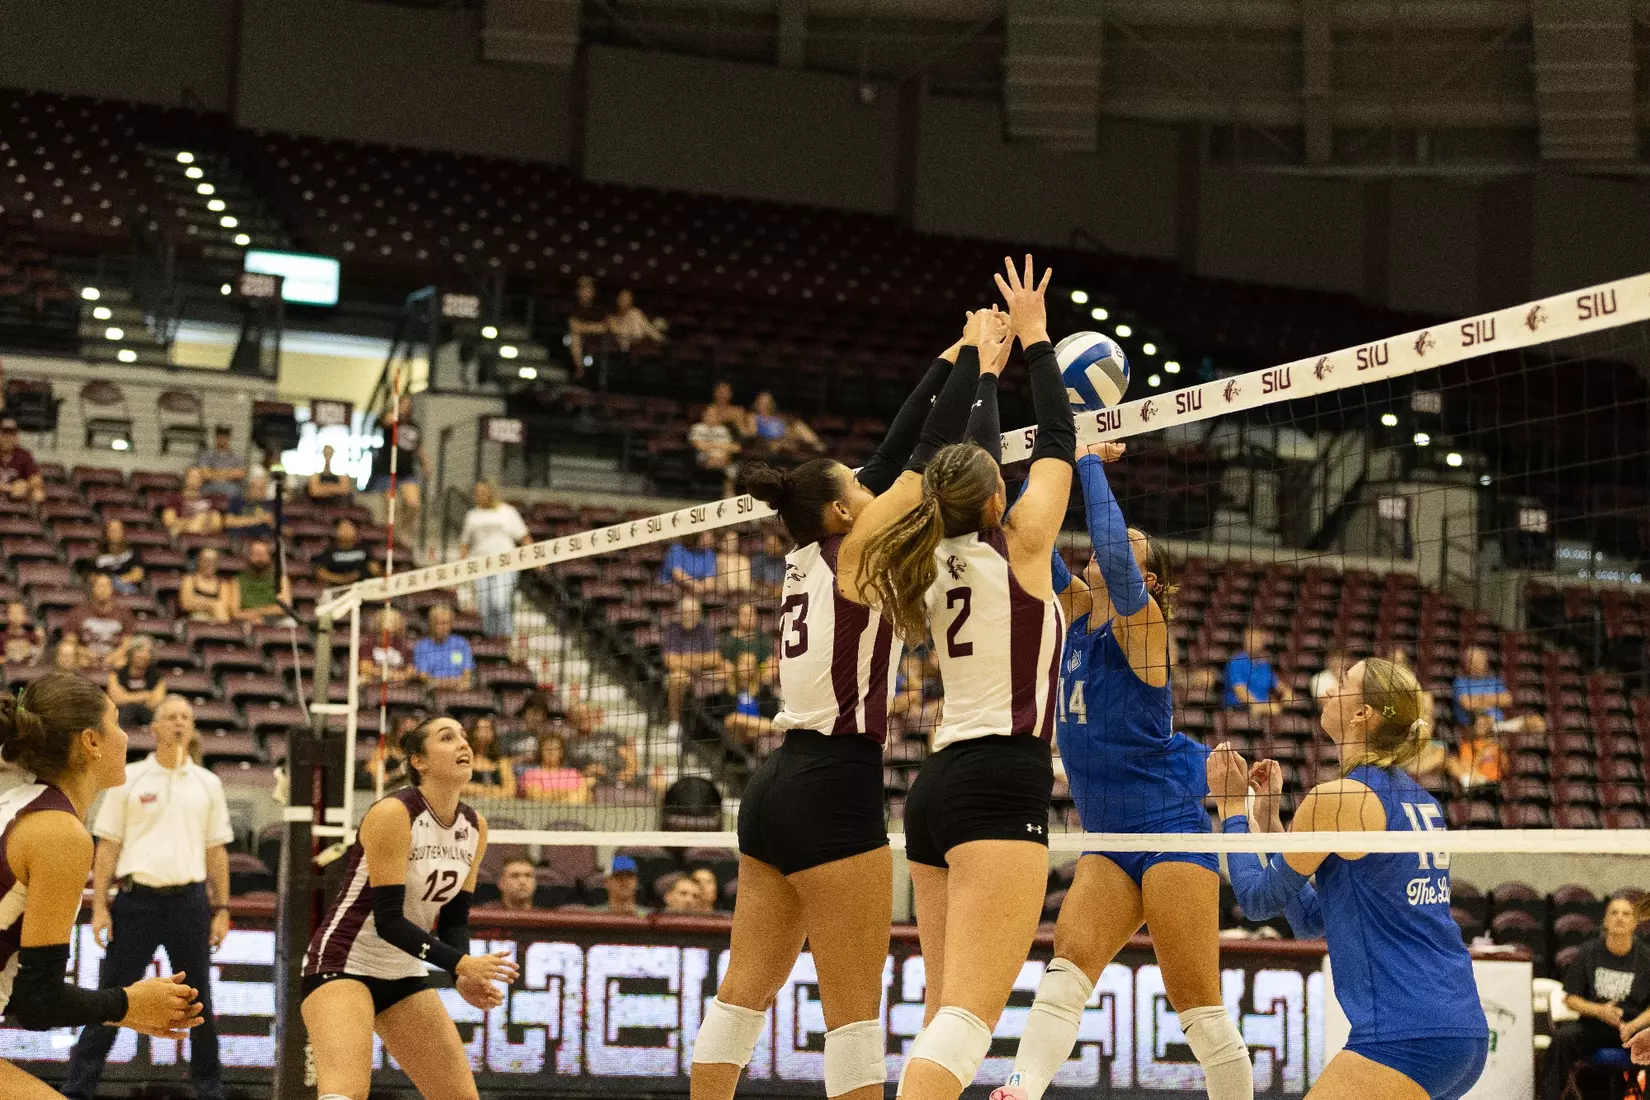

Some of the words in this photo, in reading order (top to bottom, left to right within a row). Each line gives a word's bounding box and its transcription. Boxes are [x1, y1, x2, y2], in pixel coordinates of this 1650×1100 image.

[1096, 409, 1121, 433] SIU
[1176, 388, 1202, 414] SIU
[1262, 367, 1291, 394] SIU
[1356, 342, 1389, 371] SIU
[1461, 318, 1496, 347] SIU
[1577, 289, 1617, 320] SIU
[533, 545, 546, 560] SIU
[569, 537, 582, 552] SIU
[607, 528, 620, 543] SIU
[647, 518, 661, 534] SIU
[690, 507, 706, 524] SIU
[737, 496, 753, 514] SIU
[946, 586, 973, 659] 2
[1059, 677, 1088, 725] 14
[421, 869, 458, 902] 12
[1406, 876, 1437, 906] The
